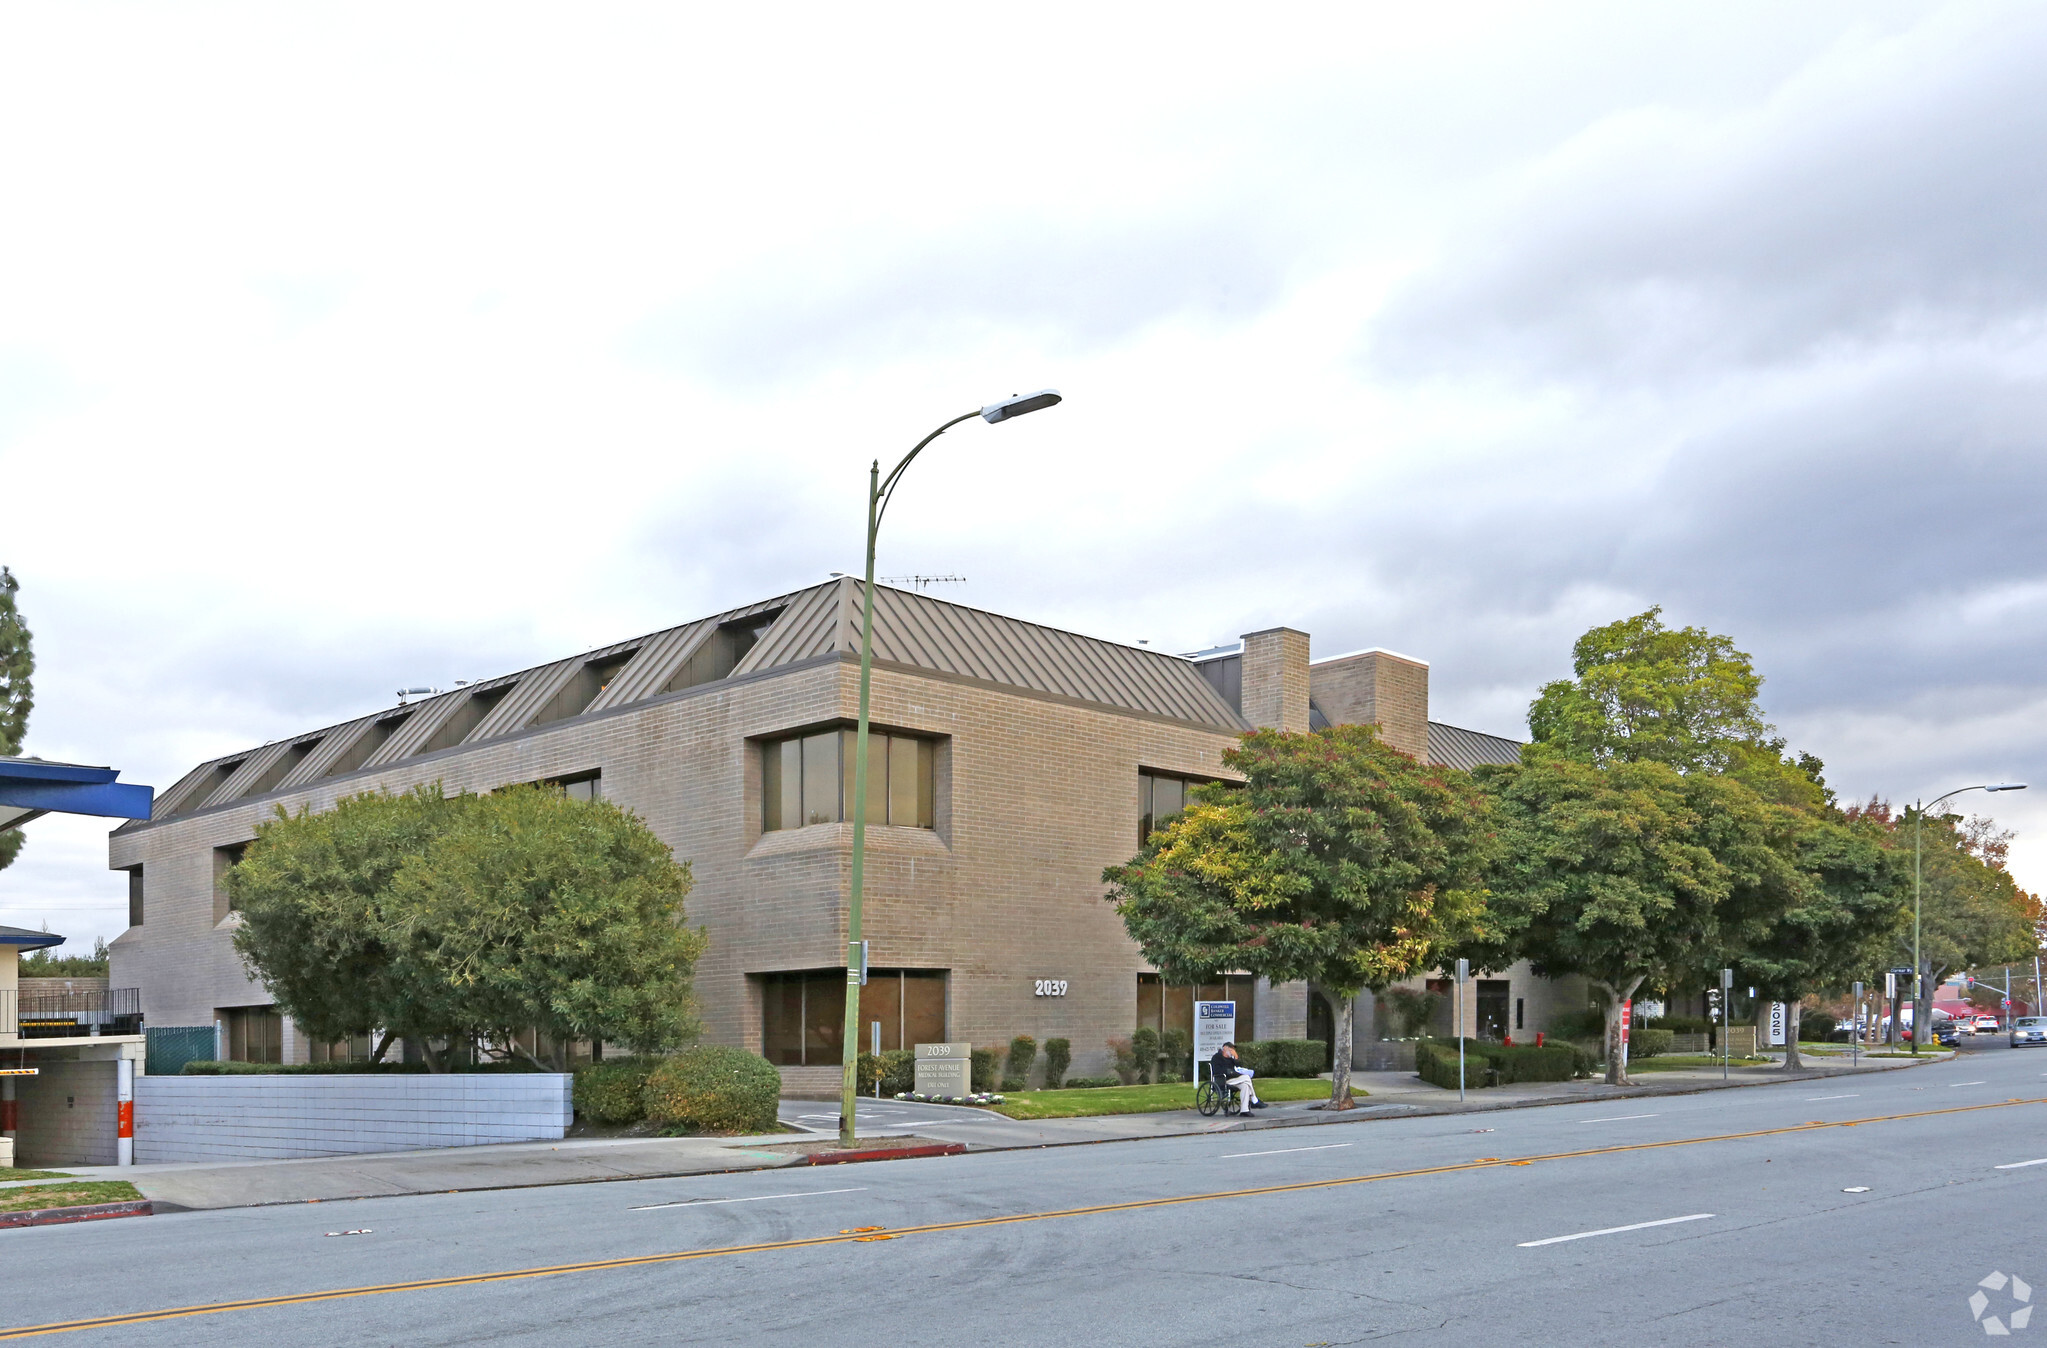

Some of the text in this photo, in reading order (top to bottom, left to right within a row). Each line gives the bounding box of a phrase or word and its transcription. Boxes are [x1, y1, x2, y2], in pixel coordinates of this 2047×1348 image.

[1035, 980, 1068, 996] 2039
[1772, 1004, 1780, 1036] 2025
[928, 1046, 950, 1056] 2039
